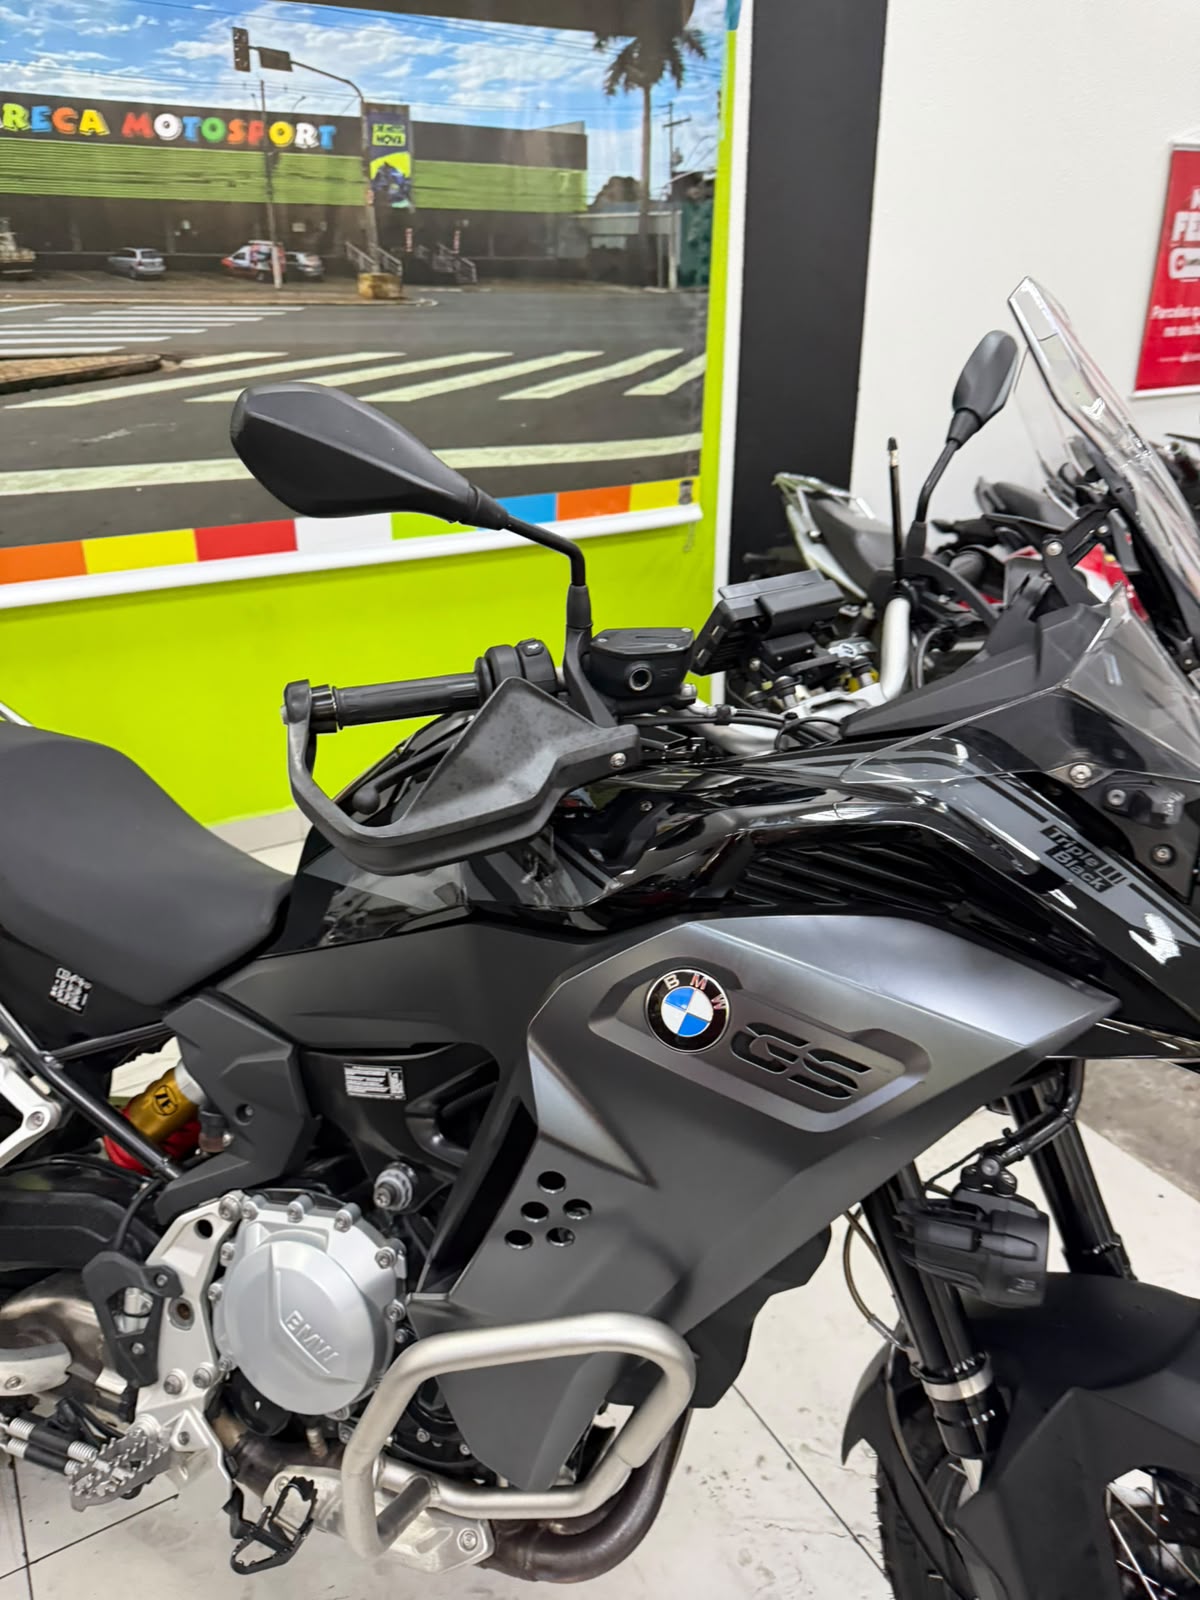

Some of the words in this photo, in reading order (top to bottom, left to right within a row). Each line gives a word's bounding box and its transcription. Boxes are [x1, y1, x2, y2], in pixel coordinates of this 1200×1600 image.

[0, 102, 110, 136] RECA
[121, 111, 336, 151] MOTOSPORT
[1049, 827, 1099, 868] Triple
[1052, 850, 1106, 890] Black
[663, 972, 727, 1011] BMW
[731, 1022, 873, 1100] GS
[285, 1309, 340, 1363] BMW
